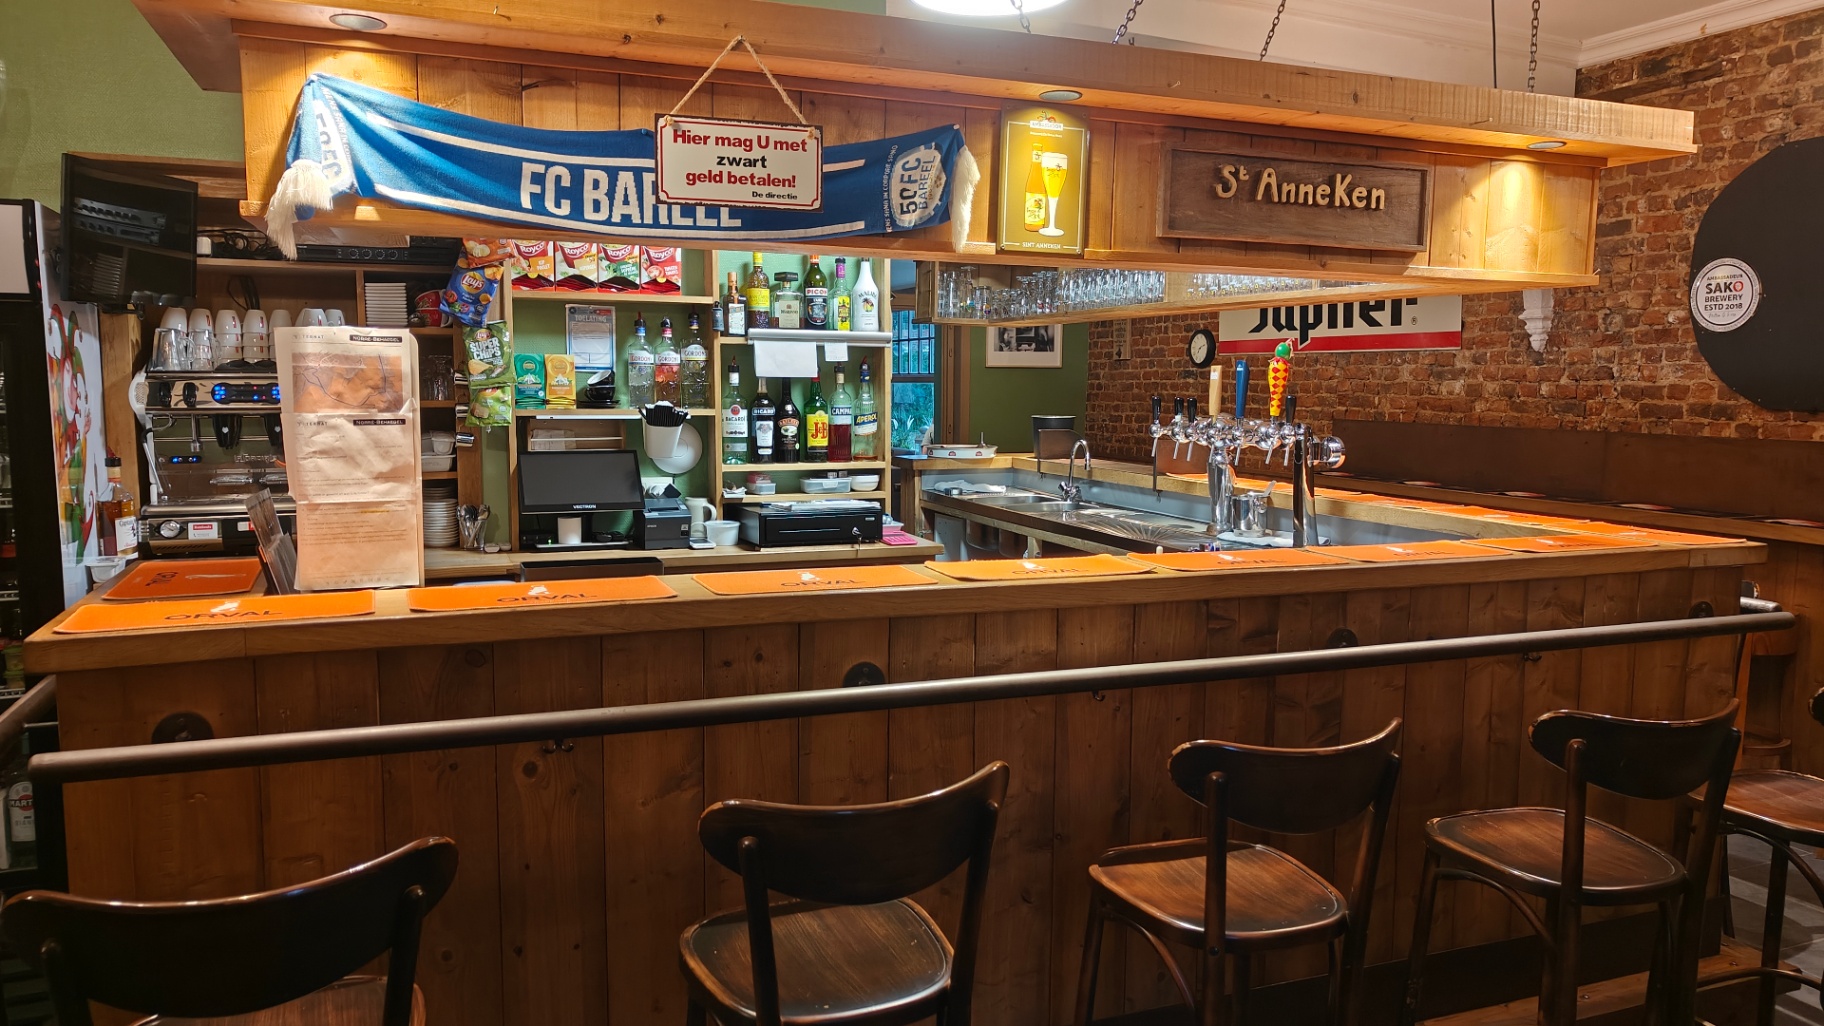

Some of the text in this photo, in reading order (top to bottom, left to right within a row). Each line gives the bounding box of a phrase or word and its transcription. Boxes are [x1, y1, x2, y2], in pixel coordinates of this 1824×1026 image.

[673, 129, 807, 152] Hier mag U met
[716, 155, 767, 168] zwart
[685, 170, 796, 188] geld betalen!
[918, 156, 936, 210] BAREEL
[1215, 164, 1250, 198] St
[520, 161, 571, 216] FC
[752, 191, 798, 200] De directie
[462, 274, 485, 291] Lay's
[1705, 280, 1744, 295] SAKO
[1704, 294, 1743, 303] BREWERY
[1704, 302, 1743, 311] ESTD 2018
[469, 337, 500, 352] SUPER
[831, 407, 852, 415] CAMPA
[856, 413, 878, 424] APEROL
[780, 579, 866, 587] ORVAL
[497, 593, 599, 603] ORVAL
[164, 609, 283, 621] ORVAL
[10, 799, 33, 808] MART
